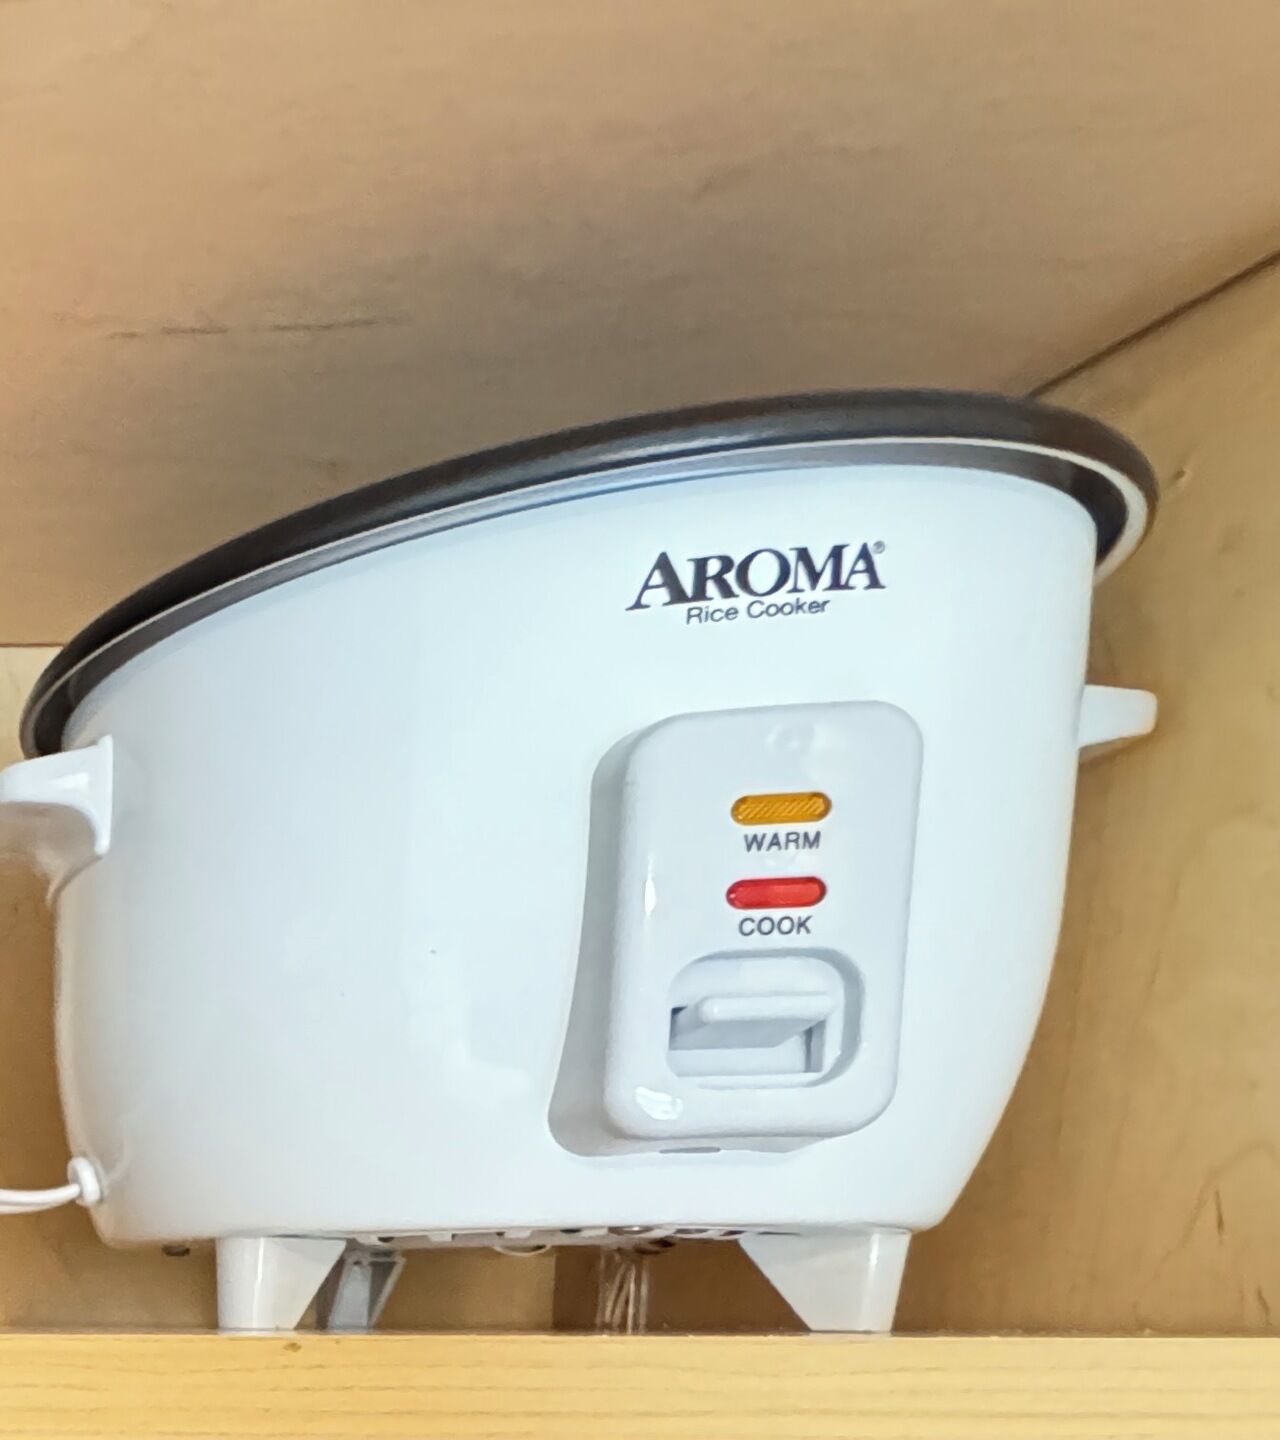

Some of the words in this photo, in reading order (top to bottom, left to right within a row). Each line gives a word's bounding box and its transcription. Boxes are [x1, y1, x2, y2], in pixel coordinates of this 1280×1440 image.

[686, 605, 739, 624] Rice
[746, 598, 831, 618] Cooker
[744, 830, 822, 853] WARM
[738, 915, 813, 936] COOK
